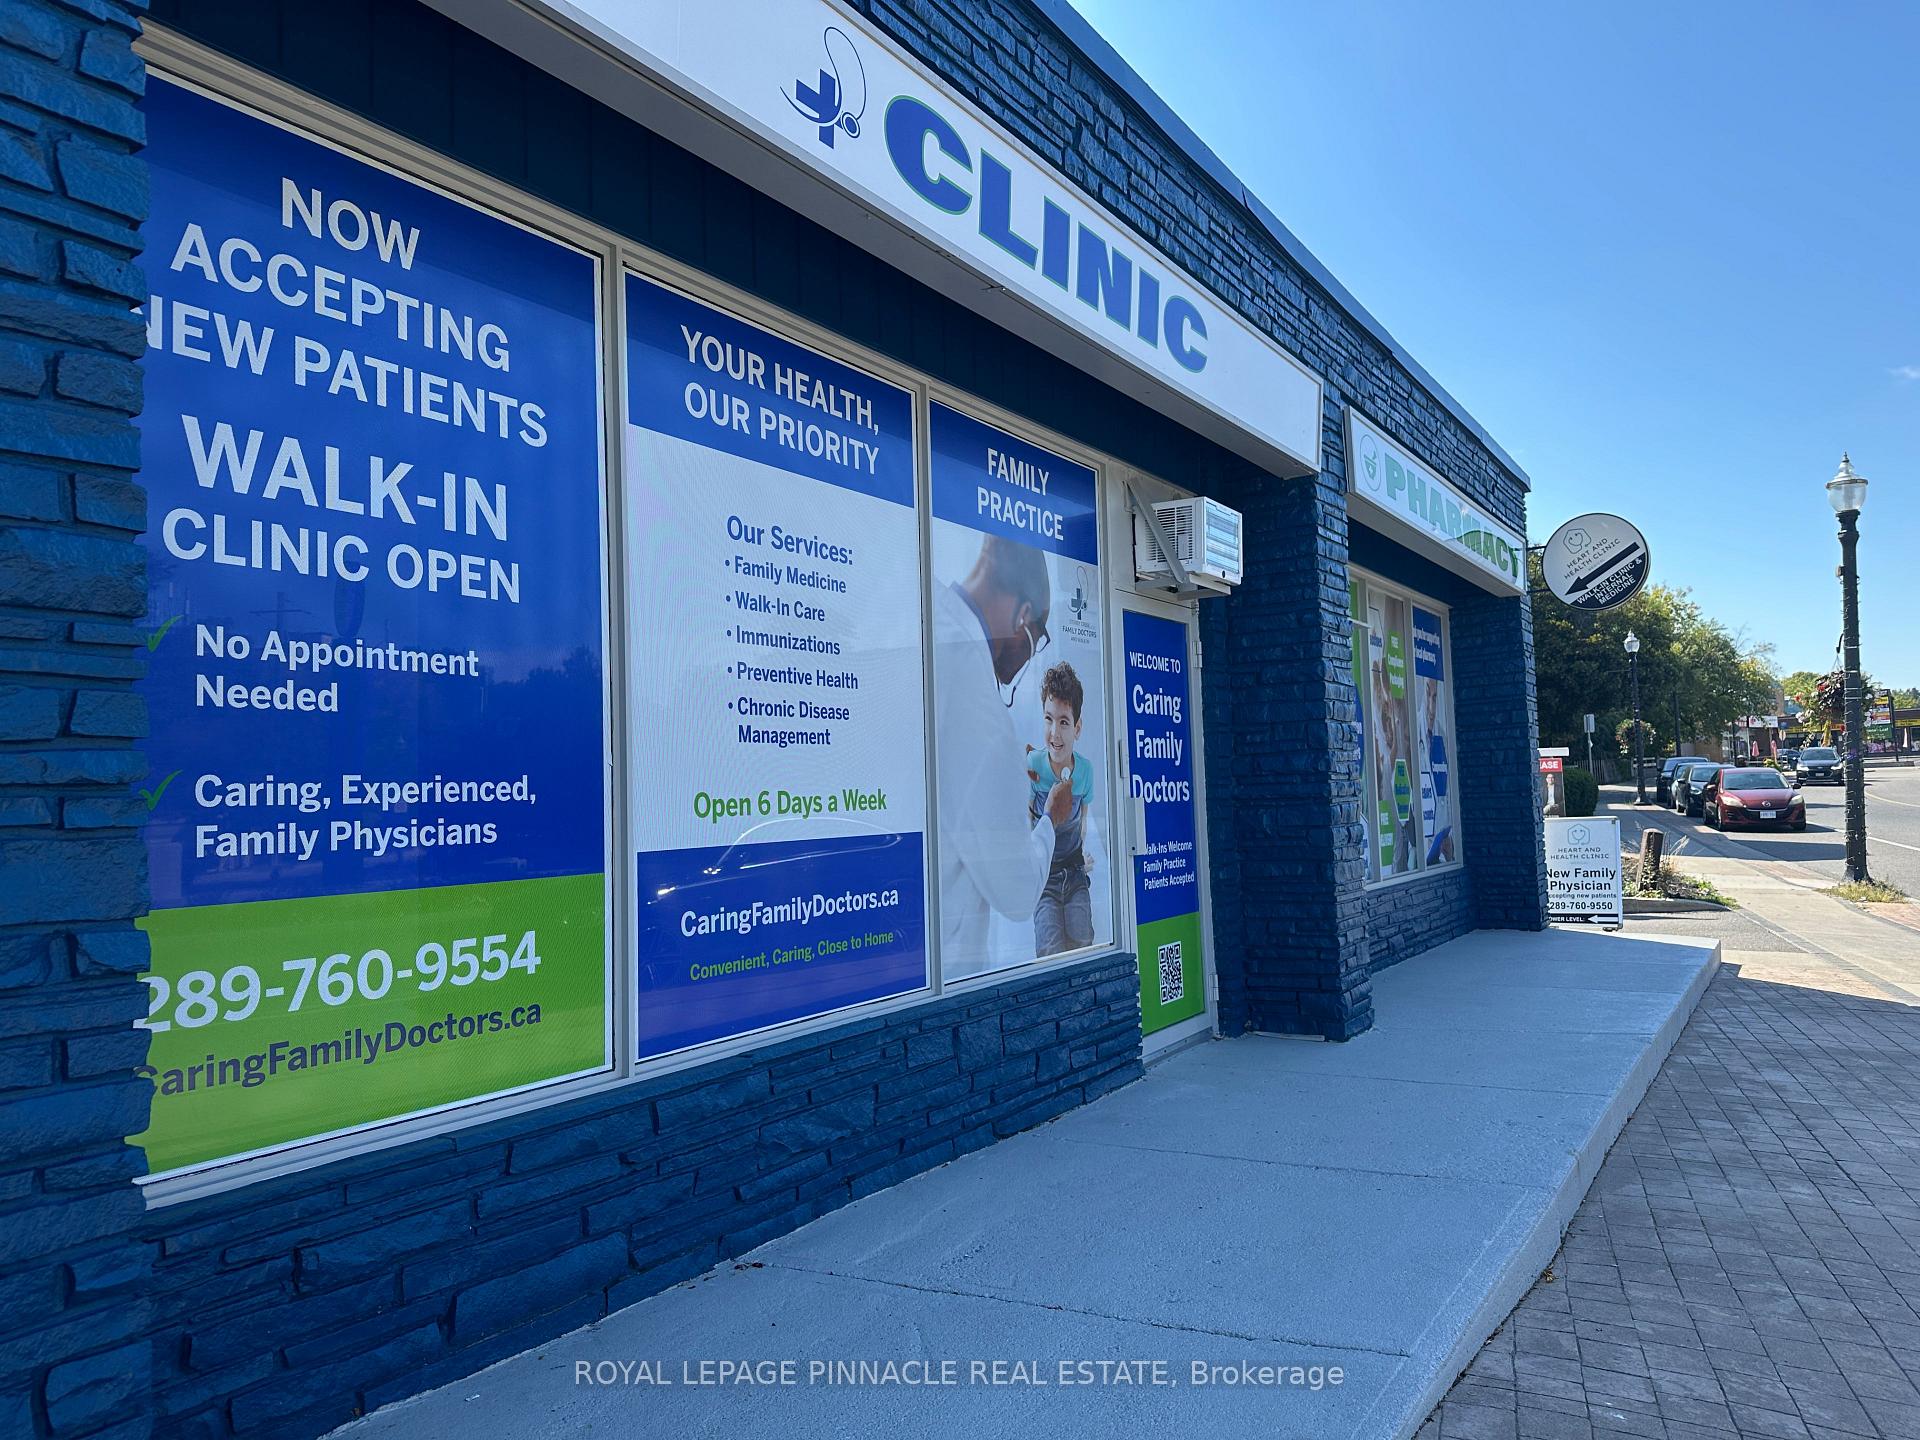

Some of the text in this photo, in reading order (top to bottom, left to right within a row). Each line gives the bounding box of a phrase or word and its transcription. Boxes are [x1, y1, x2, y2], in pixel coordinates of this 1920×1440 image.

[281, 176, 420, 271] NOW
[883, 94, 1209, 374] CLINIC
[170, 222, 510, 373] ACCEPTING
[294, 335, 548, 448] PATIENTS
[680, 323, 880, 436] YOUR HEALTH,
[684, 382, 880, 475] OUR PRIORITY
[181, 414, 508, 542] WALK-IN
[987, 447, 1050, 496] FAMILY
[976, 486, 1064, 541] PRACTICE
[1384, 451, 1519, 582] PHARMACY
[162, 507, 520, 604] CLINIC OPEN
[727, 515, 853, 565] Our Services:
[1563, 559, 1592, 580] HEALTH
[1593, 538, 1621, 560] CLINIC
[1566, 550, 1591, 569] HEART
[1592, 538, 1608, 551] AND
[734, 555, 847, 594] Family Medicine
[1576, 579, 1609, 604] WALK-IN
[1608, 562, 1636, 583] CLINIC
[1634, 557, 1643, 566] &
[1594, 573, 1634, 600] INTERNAL
[1598, 577, 1637, 605] MEDICINE
[735, 590, 826, 623] Walk-In Care
[196, 624, 479, 676] No Appointment
[736, 624, 841, 656] Immunizations
[737, 661, 859, 690] Preventive Health
[1129, 651, 1181, 674] WELCOME TO
[196, 674, 338, 712] Needed
[737, 696, 850, 721] Chronic Disease
[1132, 684, 1182, 724] Caring
[738, 724, 831, 749] Management
[1135, 729, 1183, 766] Family
[195, 774, 537, 813] Caring, Experienced,
[693, 788, 888, 824] Open 6 Days a Week
[1132, 774, 1190, 803] Doctors
[196, 818, 498, 860] Family Physicians
[1168, 840, 1193, 853] Welcome
[1143, 857, 1187, 873] Family Practice
[1144, 871, 1195, 891] Patients Accepted
[1574, 867, 1616, 880] Family
[1549, 901, 1613, 910] 289-760-9550
[1550, 880, 1611, 893] Physician
[680, 889, 899, 937] CaringFamilyDoctors.ca
[690, 930, 894, 981] Convenient, Caring, Close to Home
[132, 930, 541, 1034] 289-760-9554
